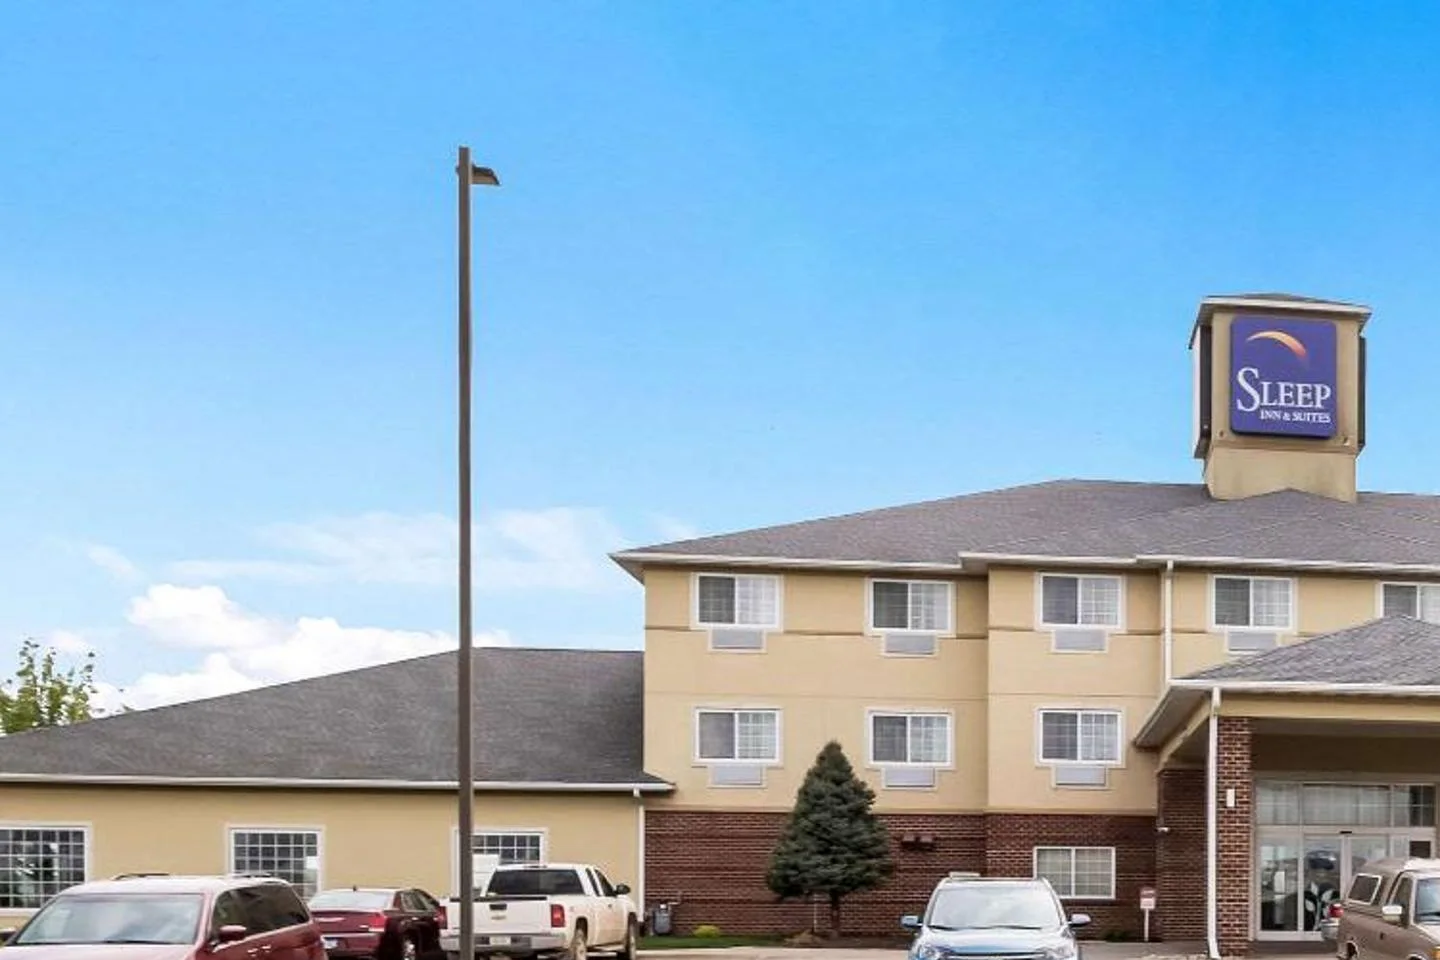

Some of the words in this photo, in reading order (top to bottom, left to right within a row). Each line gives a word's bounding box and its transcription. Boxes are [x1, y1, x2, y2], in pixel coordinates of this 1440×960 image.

[1236, 367, 1331, 412] SLEEP
[1260, 410, 1281, 420] INN
[1282, 412, 1291, 421] &
[1292, 412, 1331, 423] SUITES
